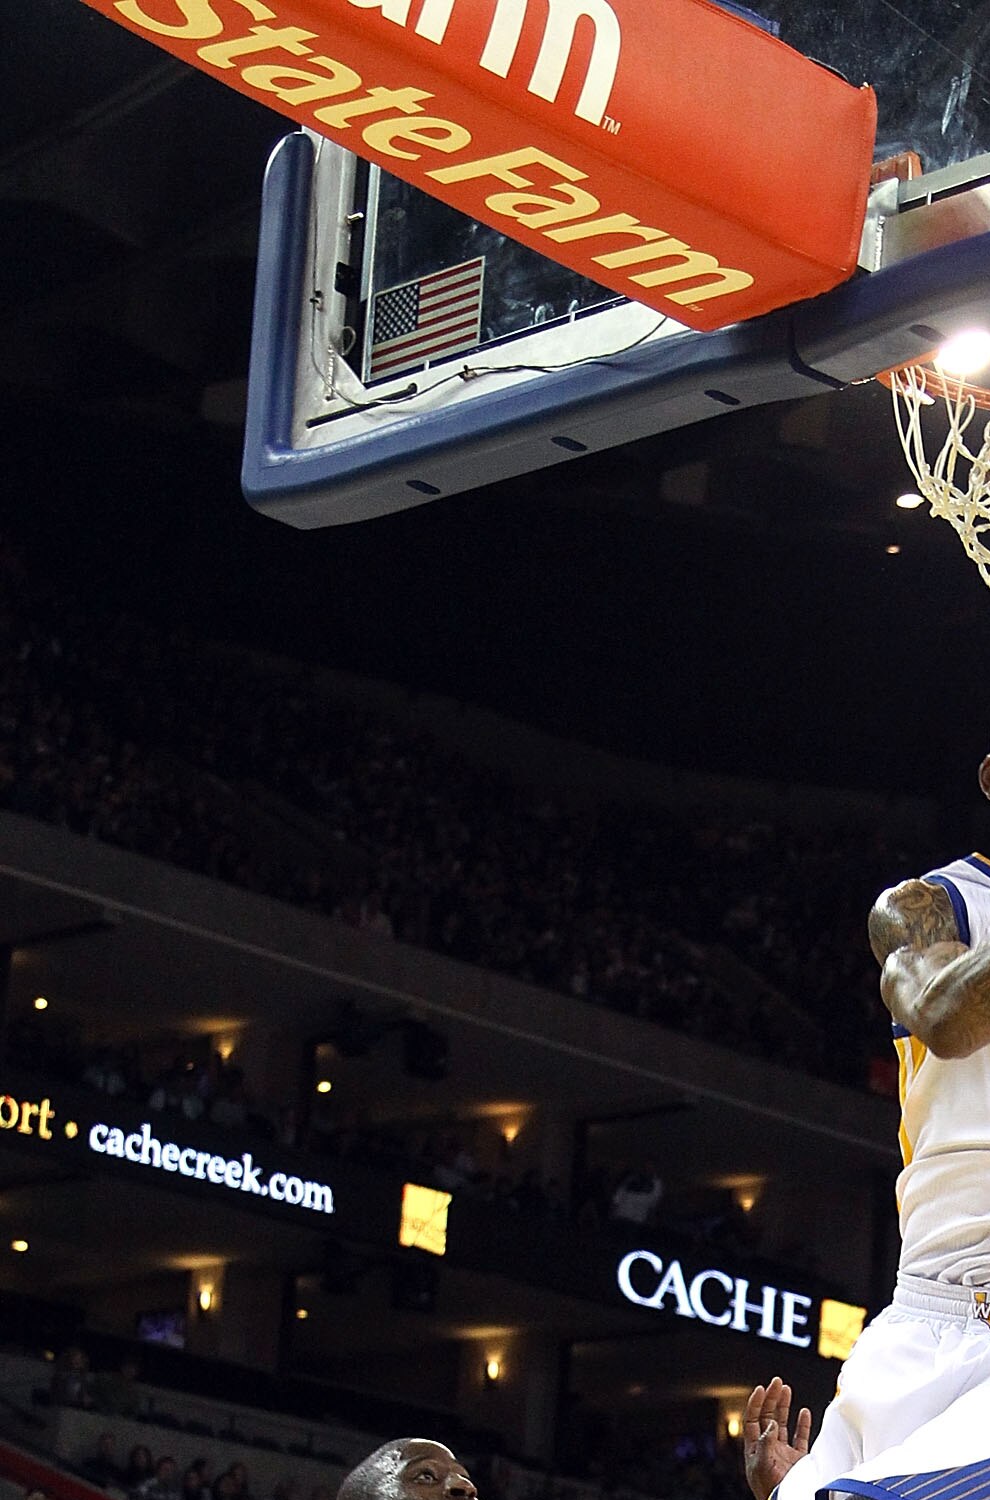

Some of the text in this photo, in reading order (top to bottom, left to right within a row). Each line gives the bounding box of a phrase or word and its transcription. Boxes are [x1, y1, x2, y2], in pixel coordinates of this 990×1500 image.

[112, 0, 472, 161] State
[425, 146, 754, 306] Farm
[89, 1123, 334, 1213] cachecreek.com
[617, 1250, 812, 1348] CACHE
